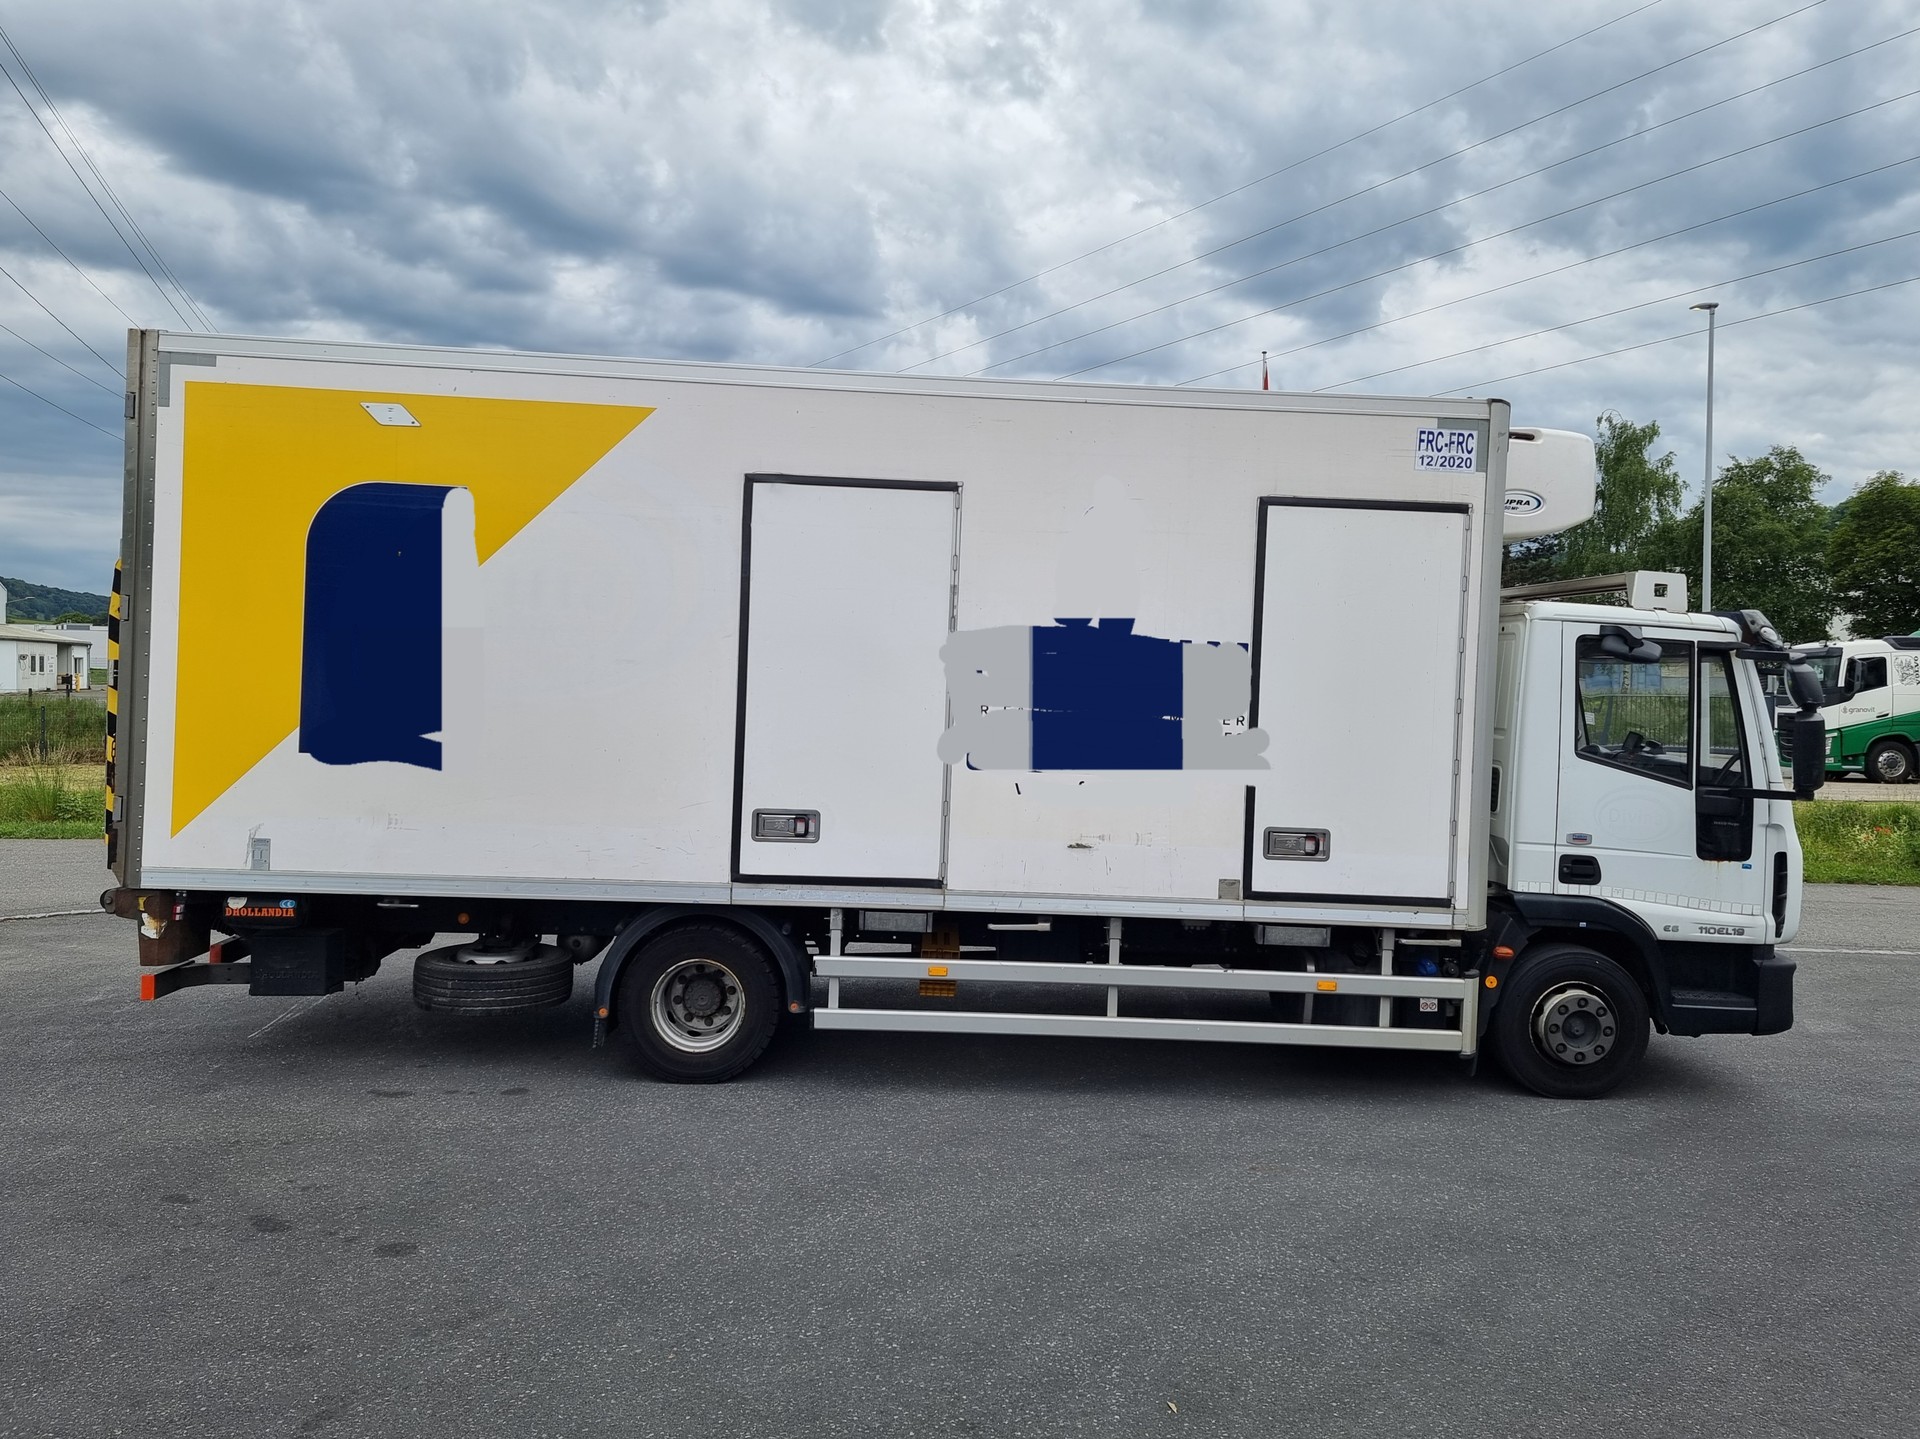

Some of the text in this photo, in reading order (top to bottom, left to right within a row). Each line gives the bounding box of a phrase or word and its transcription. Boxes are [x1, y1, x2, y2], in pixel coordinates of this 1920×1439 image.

[1419, 455, 1472, 469] 12/2020
[1504, 498, 1531, 506] UPRA
[1848, 706, 1876, 714] granovit
[225, 907, 295, 917] DHOLLANDIA
[1698, 926, 1745, 936] 110EL19
